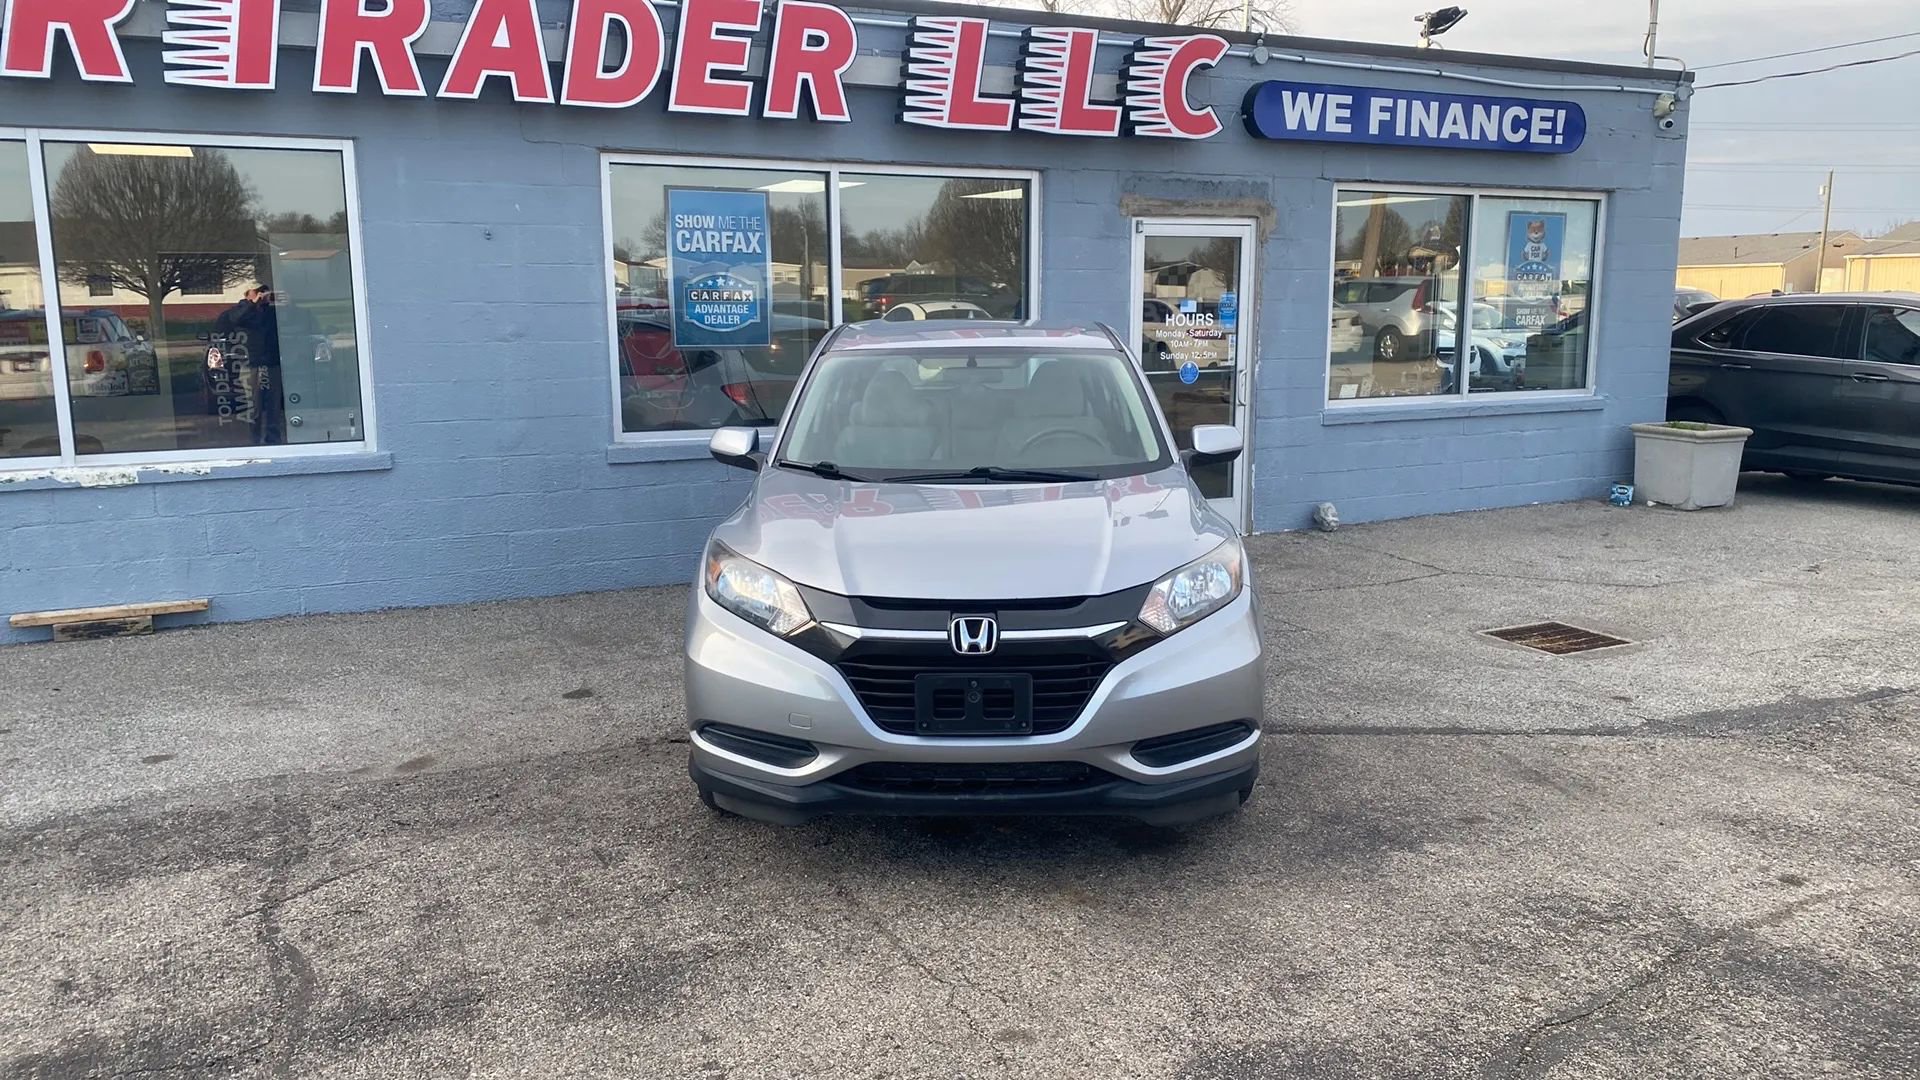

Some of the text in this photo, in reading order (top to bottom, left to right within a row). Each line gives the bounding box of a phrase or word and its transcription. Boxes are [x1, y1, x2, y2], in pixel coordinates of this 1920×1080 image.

[903, 16, 1231, 139] LLC
[1281, 90, 1567, 145] WE FINANCE!
[675, 214, 761, 231] SHOW ME THE
[676, 230, 762, 254] CARFAX
[689, 290, 753, 302] CARFAX
[694, 304, 749, 314] ADVANTAGE
[704, 314, 741, 325] DEALER
[1165, 313, 1214, 327] HOURS
[1516, 316, 1546, 326] CARFAX
[1160, 351, 1188, 361] Sunday
[228, 330, 256, 425] AWARDS
[258, 364, 271, 391] 2025
[216, 396, 233, 427] TOP
